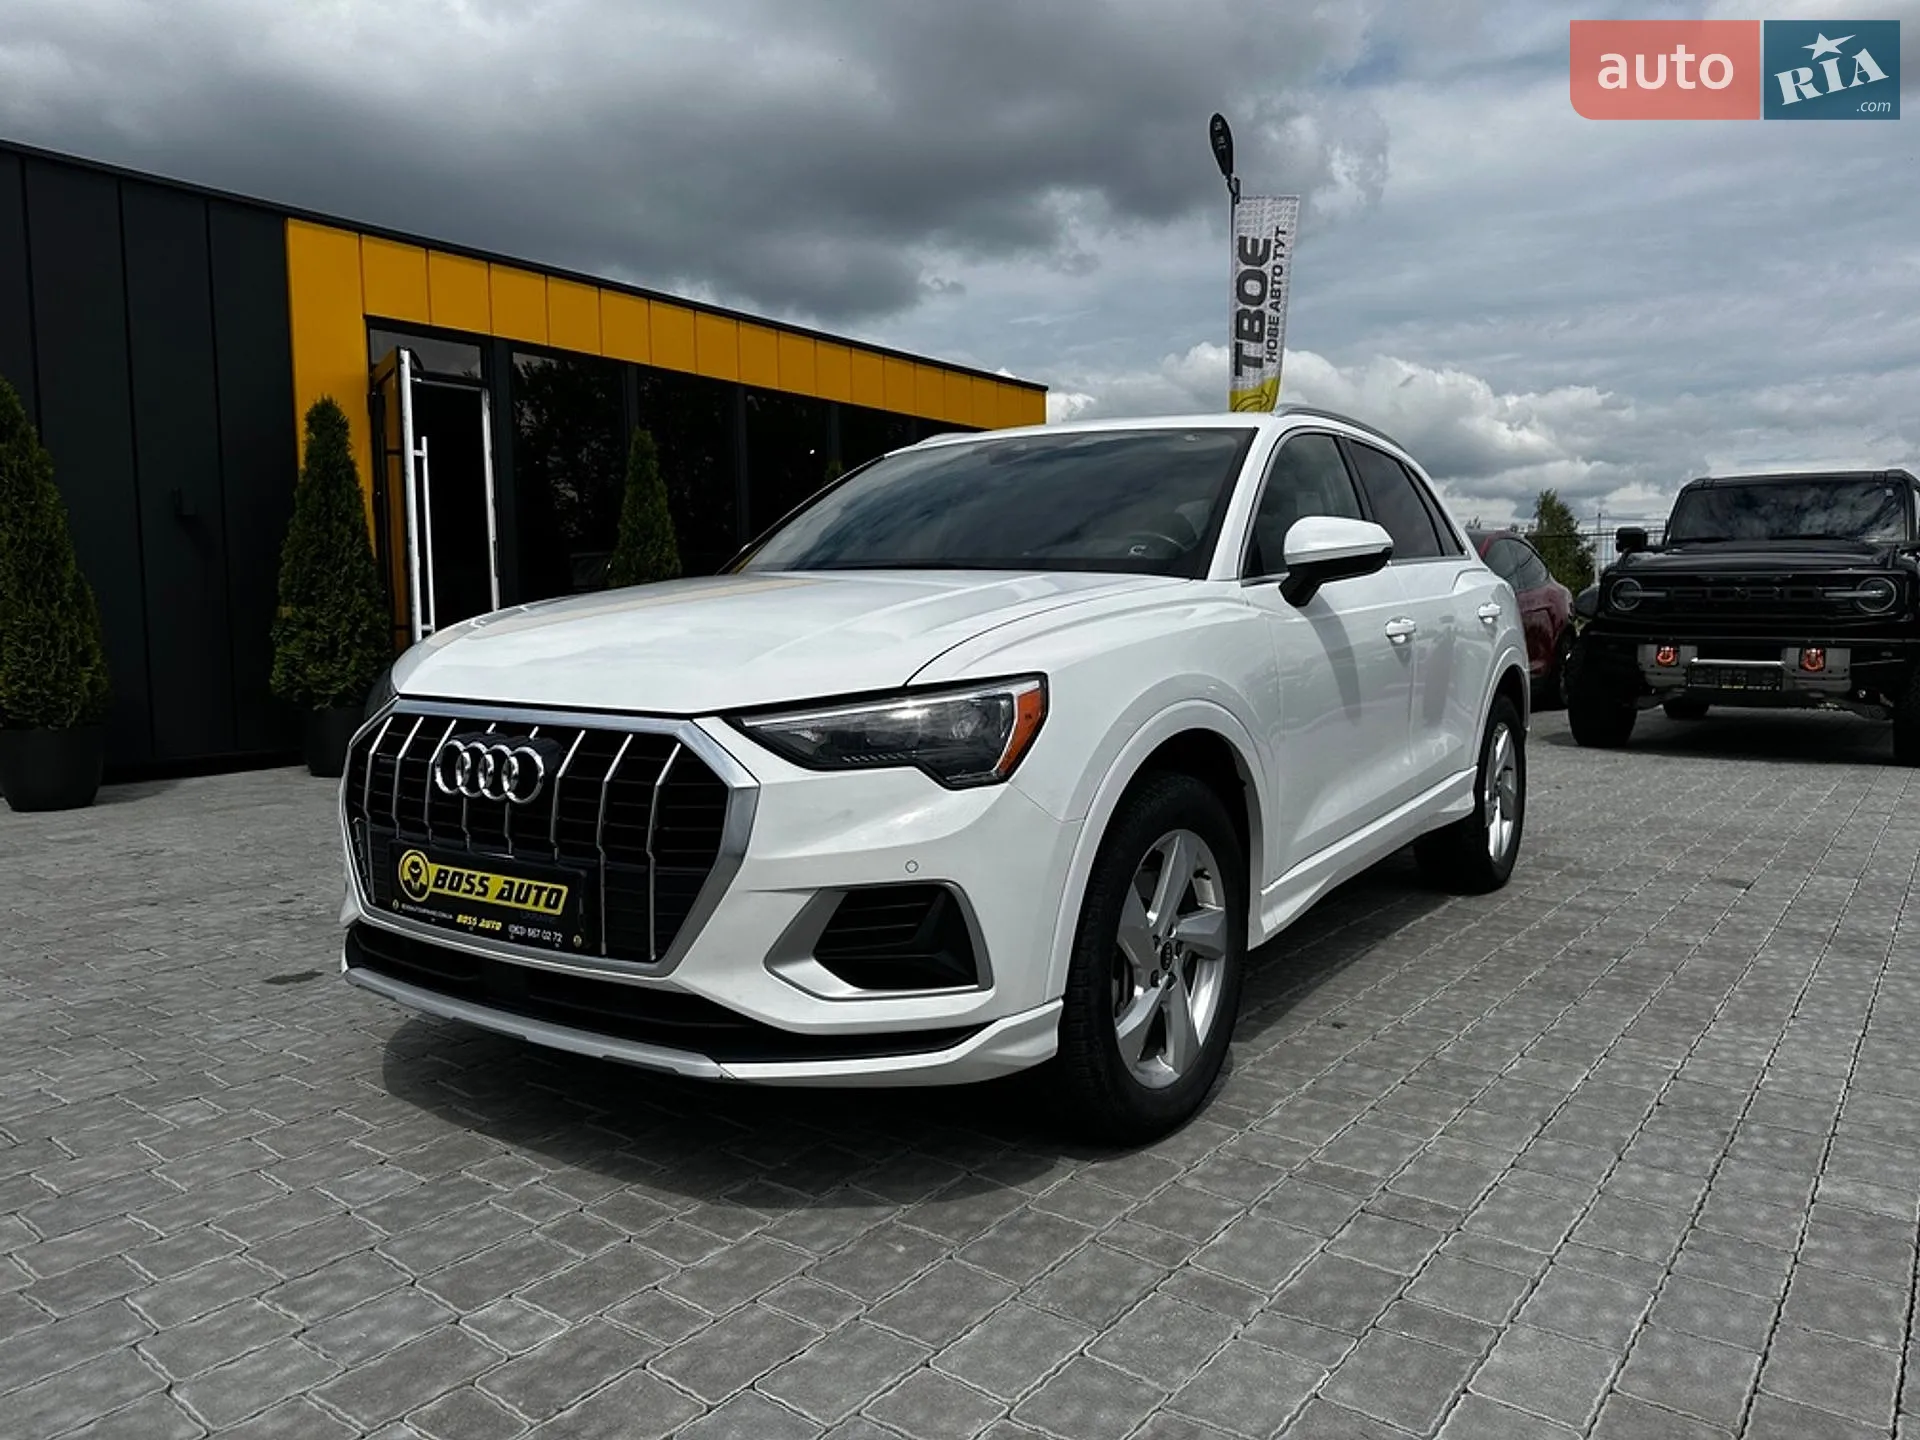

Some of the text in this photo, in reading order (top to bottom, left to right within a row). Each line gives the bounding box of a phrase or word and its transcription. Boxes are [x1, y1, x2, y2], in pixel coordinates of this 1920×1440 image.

[1234, 235, 1271, 377] ТВОЄ
[1265, 226, 1287, 363] НОВЕ АВТО ТУТ
[433, 868, 564, 910] BOSS AUTO
